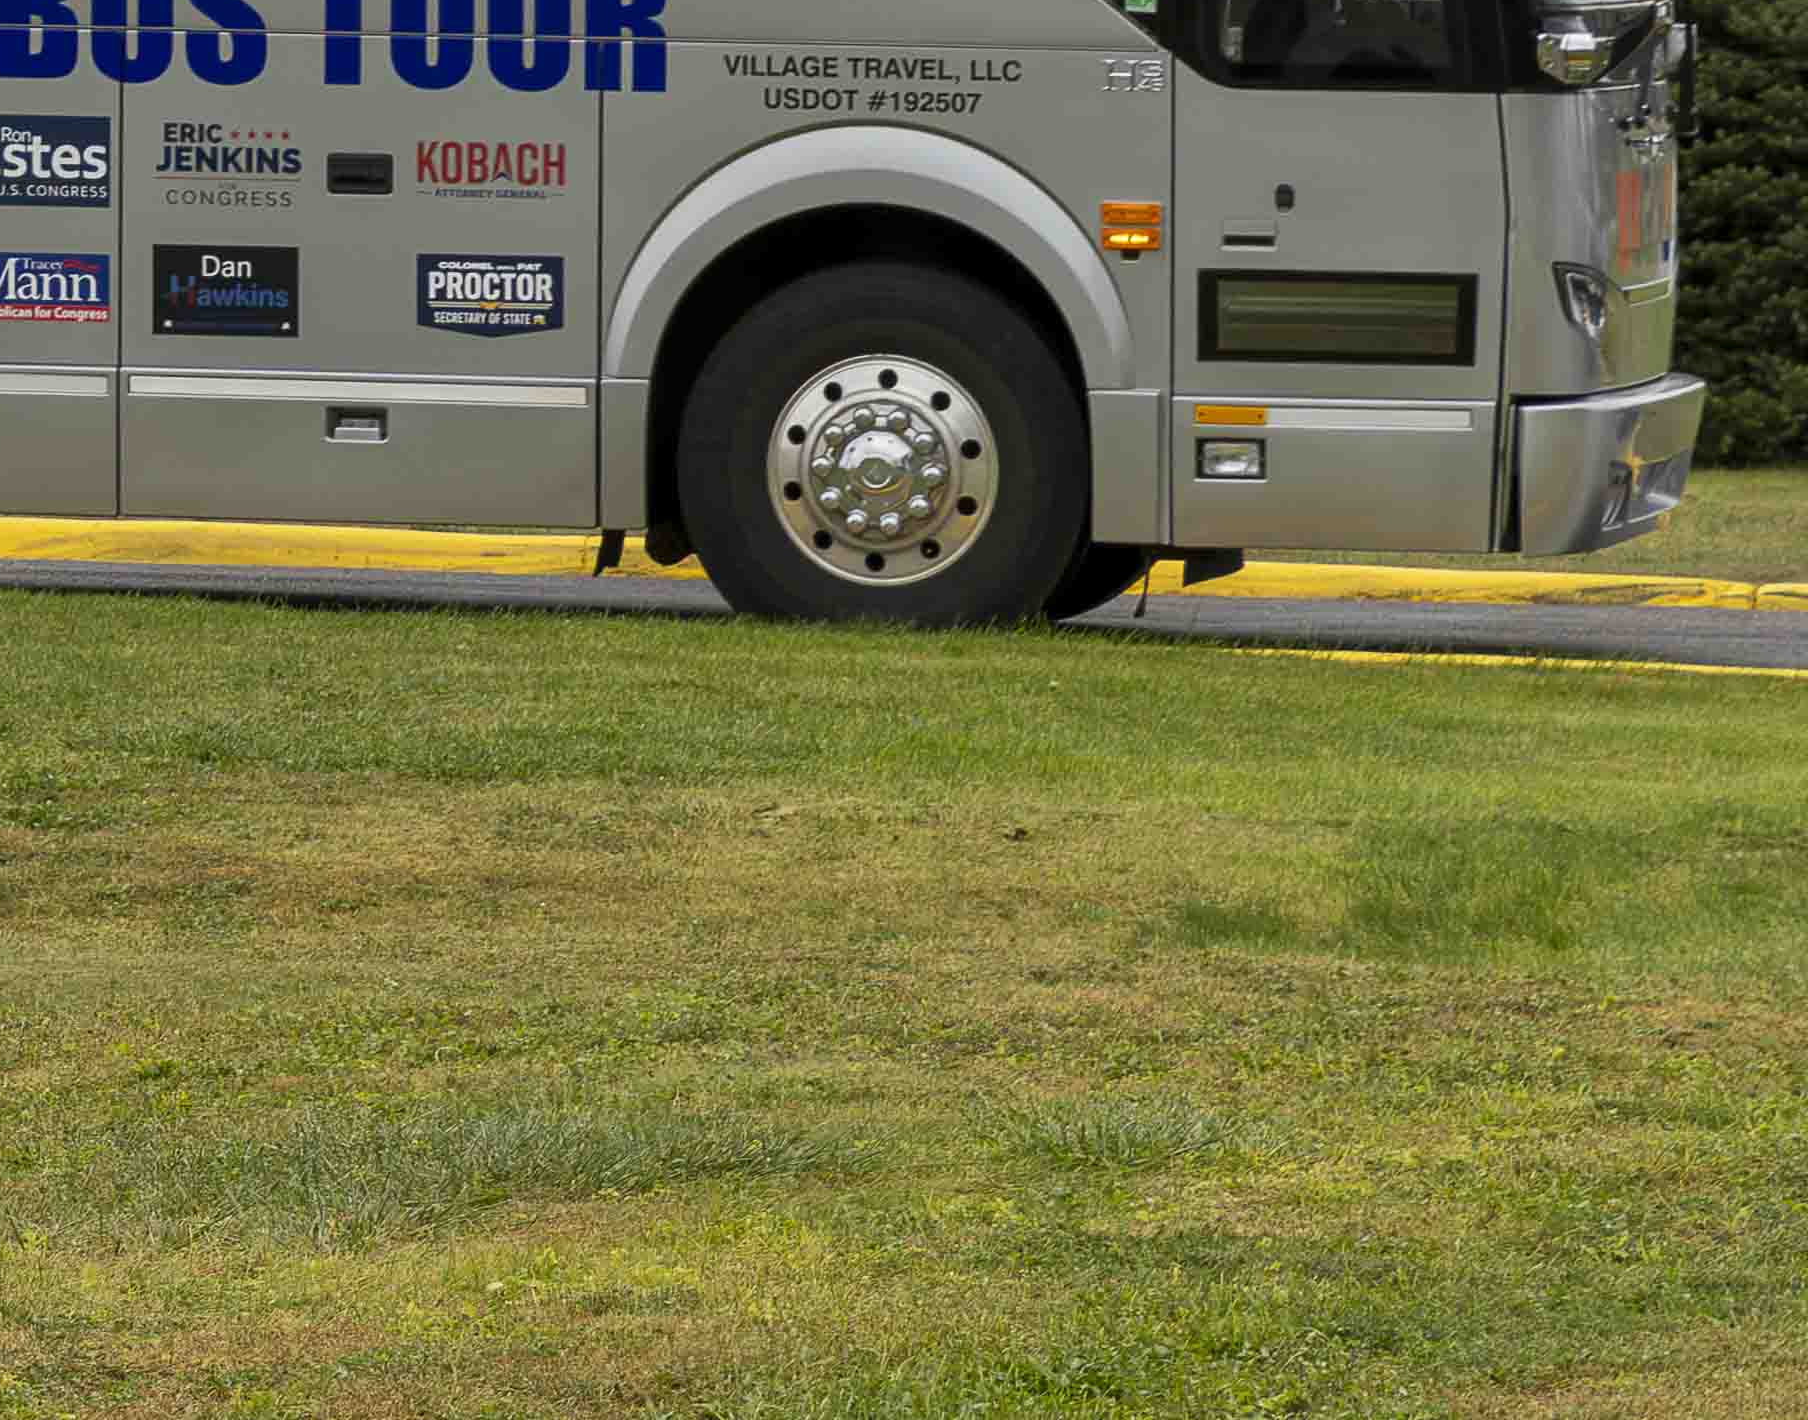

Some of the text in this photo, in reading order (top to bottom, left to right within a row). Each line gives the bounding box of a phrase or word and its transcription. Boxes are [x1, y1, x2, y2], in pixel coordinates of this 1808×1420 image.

[723, 54, 1023, 85] VILLAGE TRAVEL, LLC
[764, 87, 983, 115] USDOT #192507
[0, 126, 32, 143] Ron
[163, 122, 223, 144] ERIC
[155, 145, 303, 174] JENKINS
[416, 141, 567, 187] KOBACH
[26, 184, 108, 199] CONGRESS
[165, 188, 293, 207] CONGRESS
[23, 258, 64, 272] Tracey
[201, 254, 252, 278] Dan
[168, 274, 289, 308] Hawkins
[427, 271, 554, 301] PROCTOR
[35, 306, 52, 319] for
[54, 306, 108, 323] Congress
[433, 311, 531, 325] SECRETARY OF STATE
